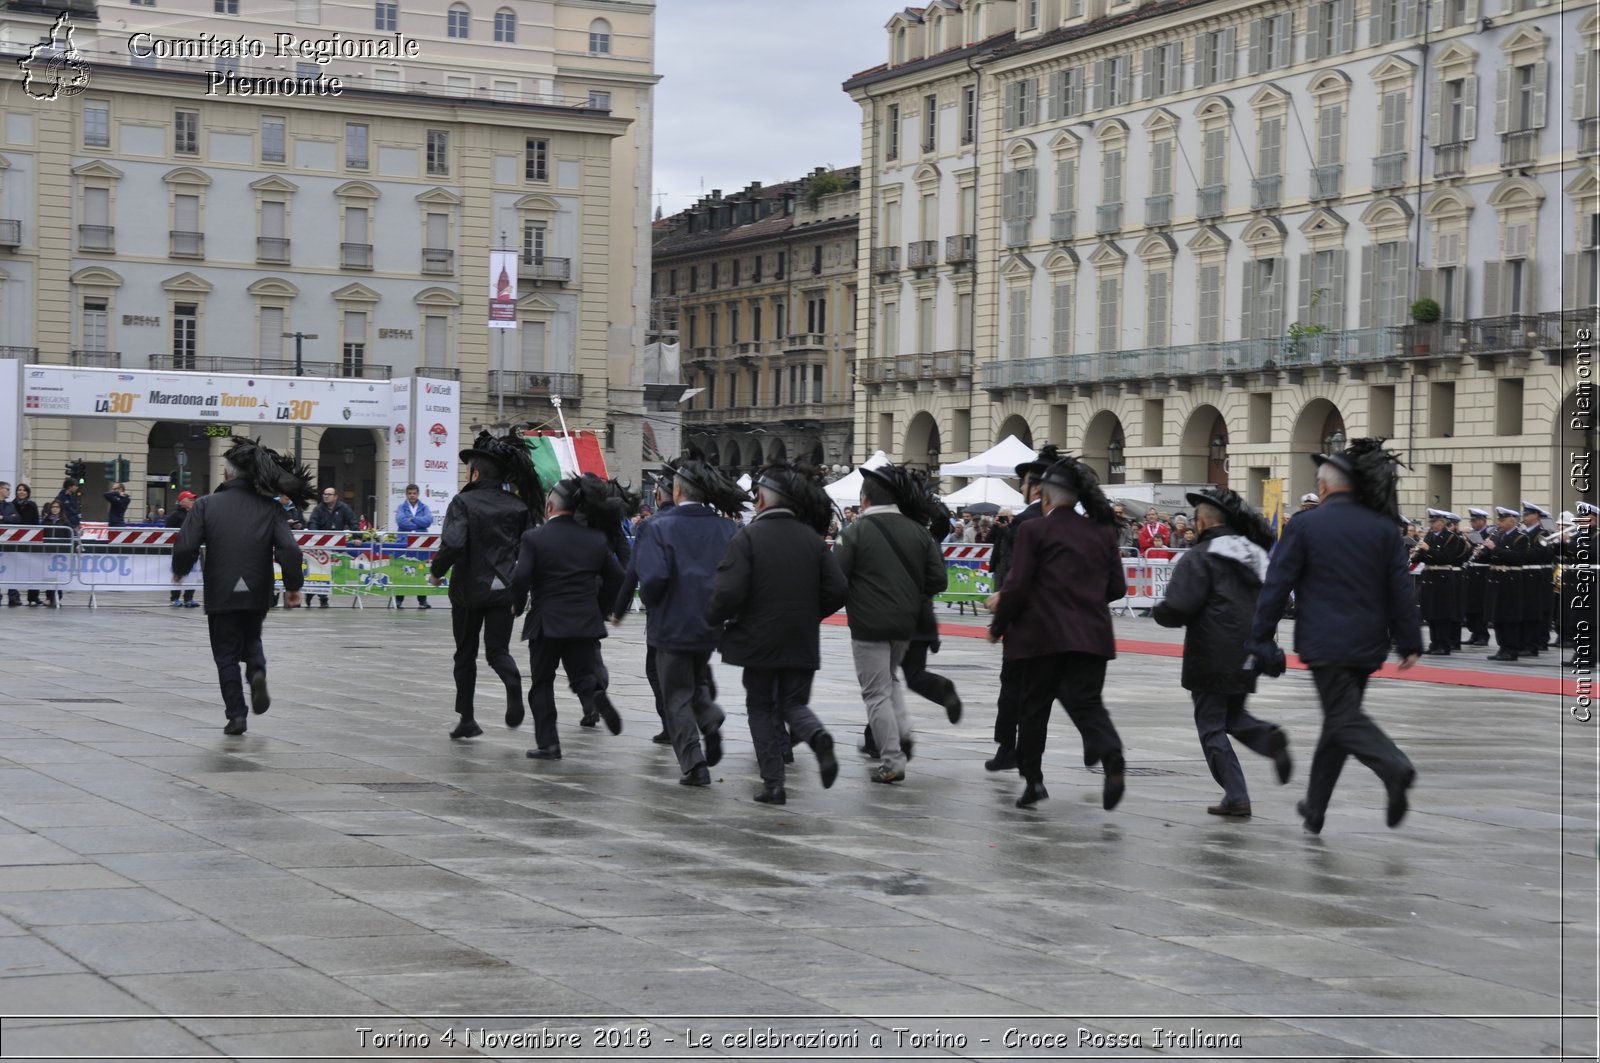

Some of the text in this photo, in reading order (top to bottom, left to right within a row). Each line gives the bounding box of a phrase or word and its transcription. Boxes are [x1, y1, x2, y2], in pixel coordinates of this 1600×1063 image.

[149, 390, 257, 407] Maratona di Torino
[424, 460, 449, 470] GIMAX
